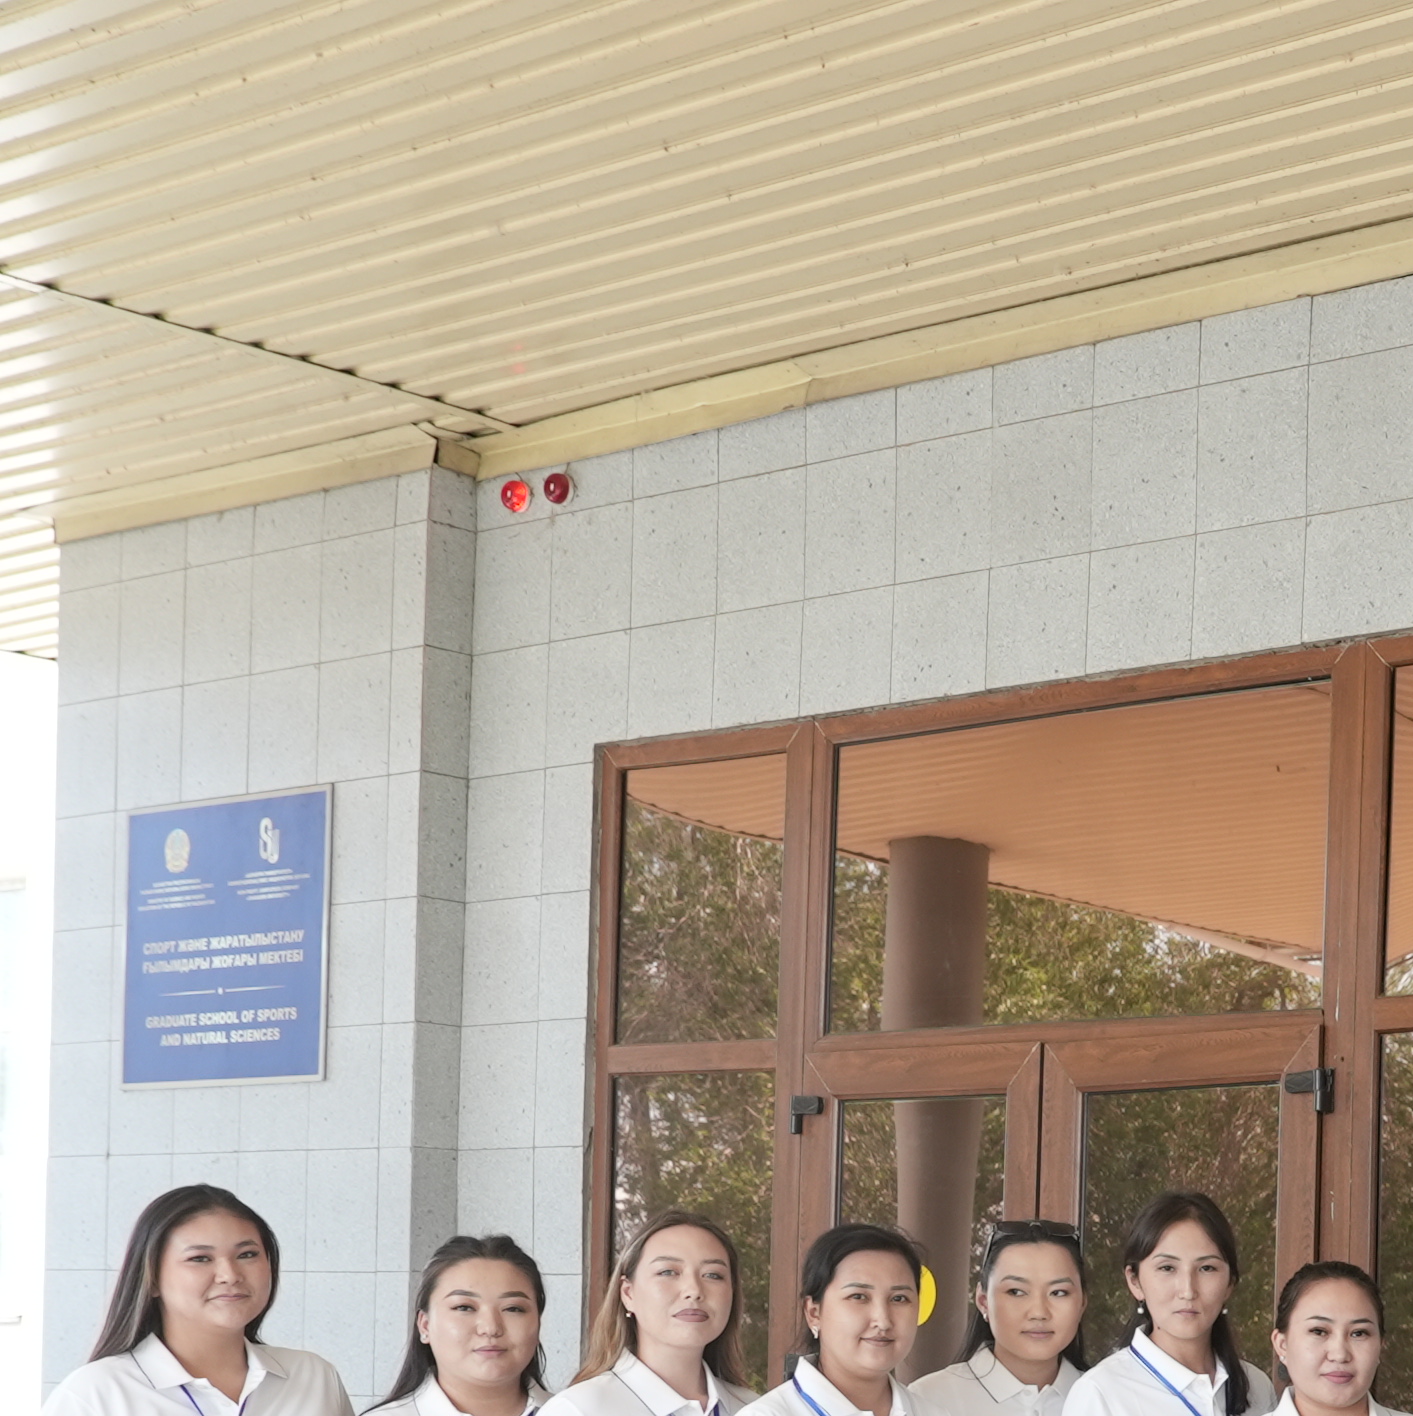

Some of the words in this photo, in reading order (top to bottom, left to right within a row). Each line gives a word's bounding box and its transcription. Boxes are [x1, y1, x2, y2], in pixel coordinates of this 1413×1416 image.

[143, 941, 176, 955] СПОРТ
[178, 938, 209, 952] ЖӘНЕ
[209, 930, 304, 950] ЖАРАТЫЛЫСТАНУ
[145, 1013, 197, 1028] GRADUATE
[198, 1011, 239, 1026] SCHOOL
[240, 1010, 255, 1022] OF
[257, 1007, 298, 1022] SPORTS
[159, 1034, 181, 1046] AND
[182, 1031, 229, 1045] NATURAL
[230, 1028, 281, 1043] SCIENCES
